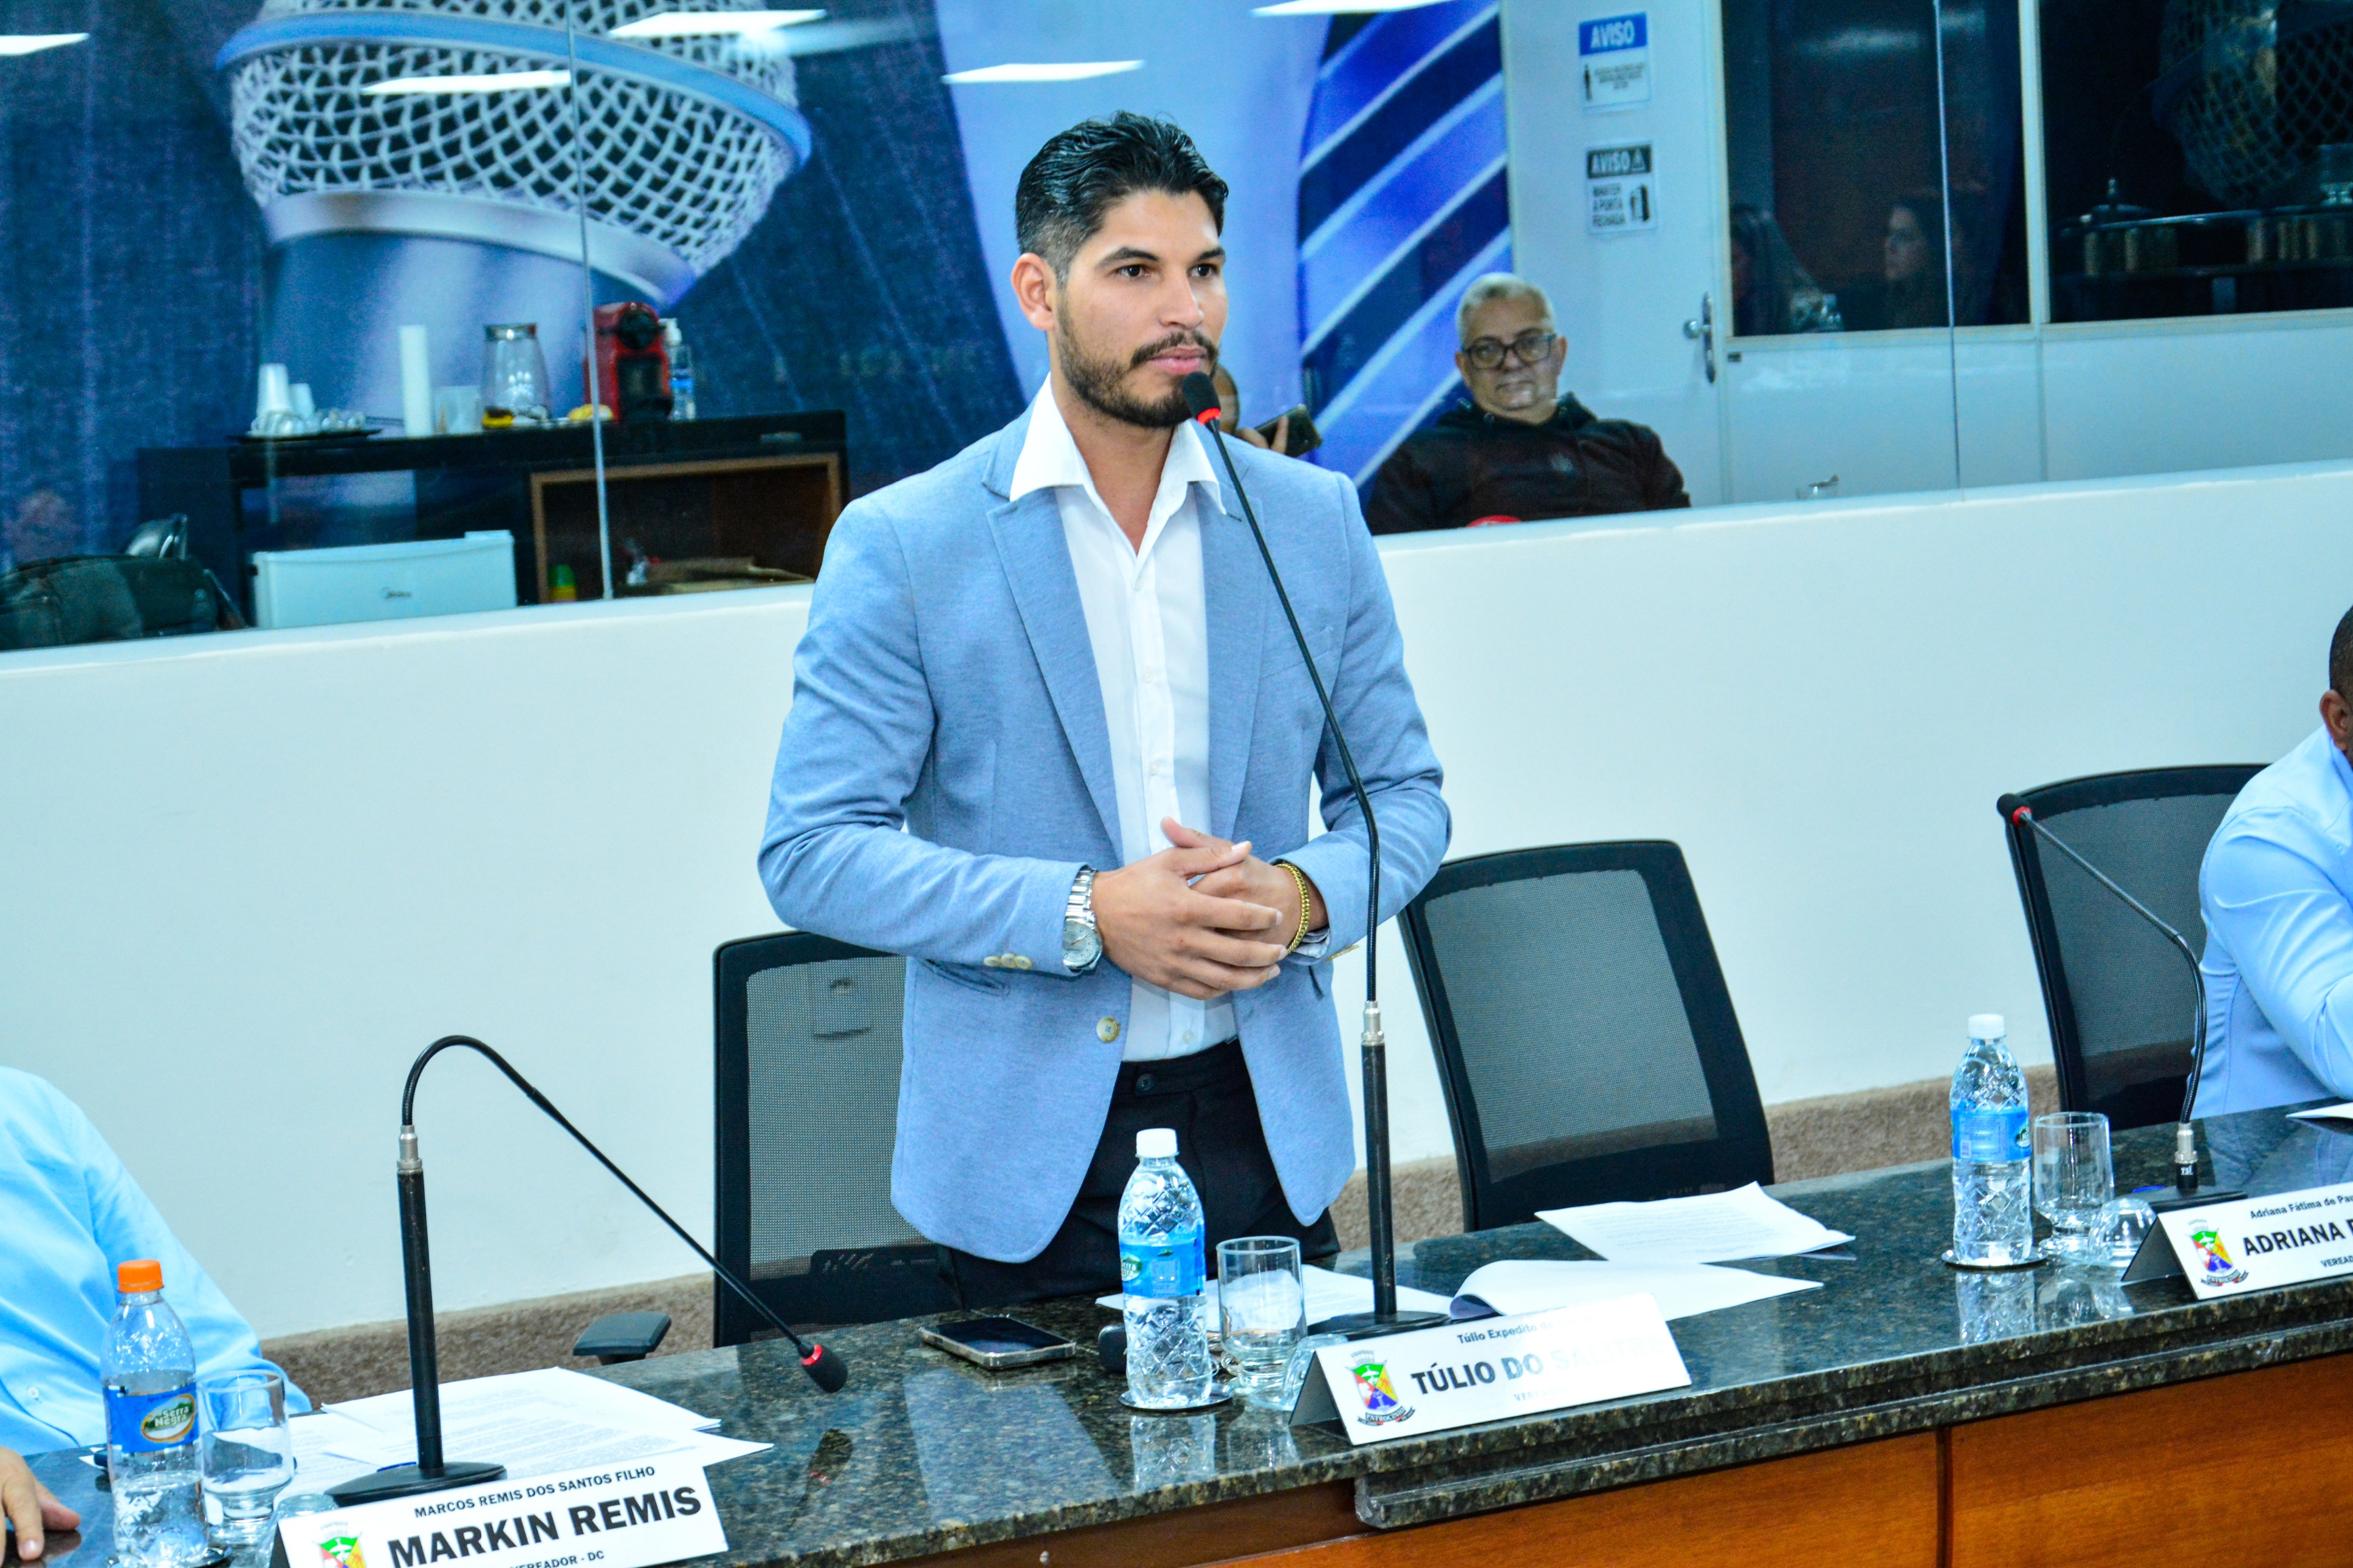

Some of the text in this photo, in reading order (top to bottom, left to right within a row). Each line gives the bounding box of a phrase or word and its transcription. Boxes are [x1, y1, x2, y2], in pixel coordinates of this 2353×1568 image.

[1591, 19, 1635, 49] AVISO
[1592, 151, 1630, 173] AVISO
[2250, 1207, 2287, 1219] Adriana
[2289, 1200, 2322, 1212] Fátima
[2324, 1197, 2337, 1206] de
[2243, 1222, 2346, 1256] ADRIANA
[1457, 1332, 1486, 1344] Túlio
[1488, 1324, 1537, 1339] Expedito
[1410, 1361, 1496, 1395] TÚLIO
[1500, 1353, 1544, 1380] DO
[155, 1414, 187, 1426] Negra
[162, 1406, 189, 1419] Serra
[414, 1466, 655, 1518] MARCOS REMIS DOS SANTOS FILHO
[387, 1486, 701, 1568] MARKIN REMIS
[587, 1550, 604, 1561] DC
